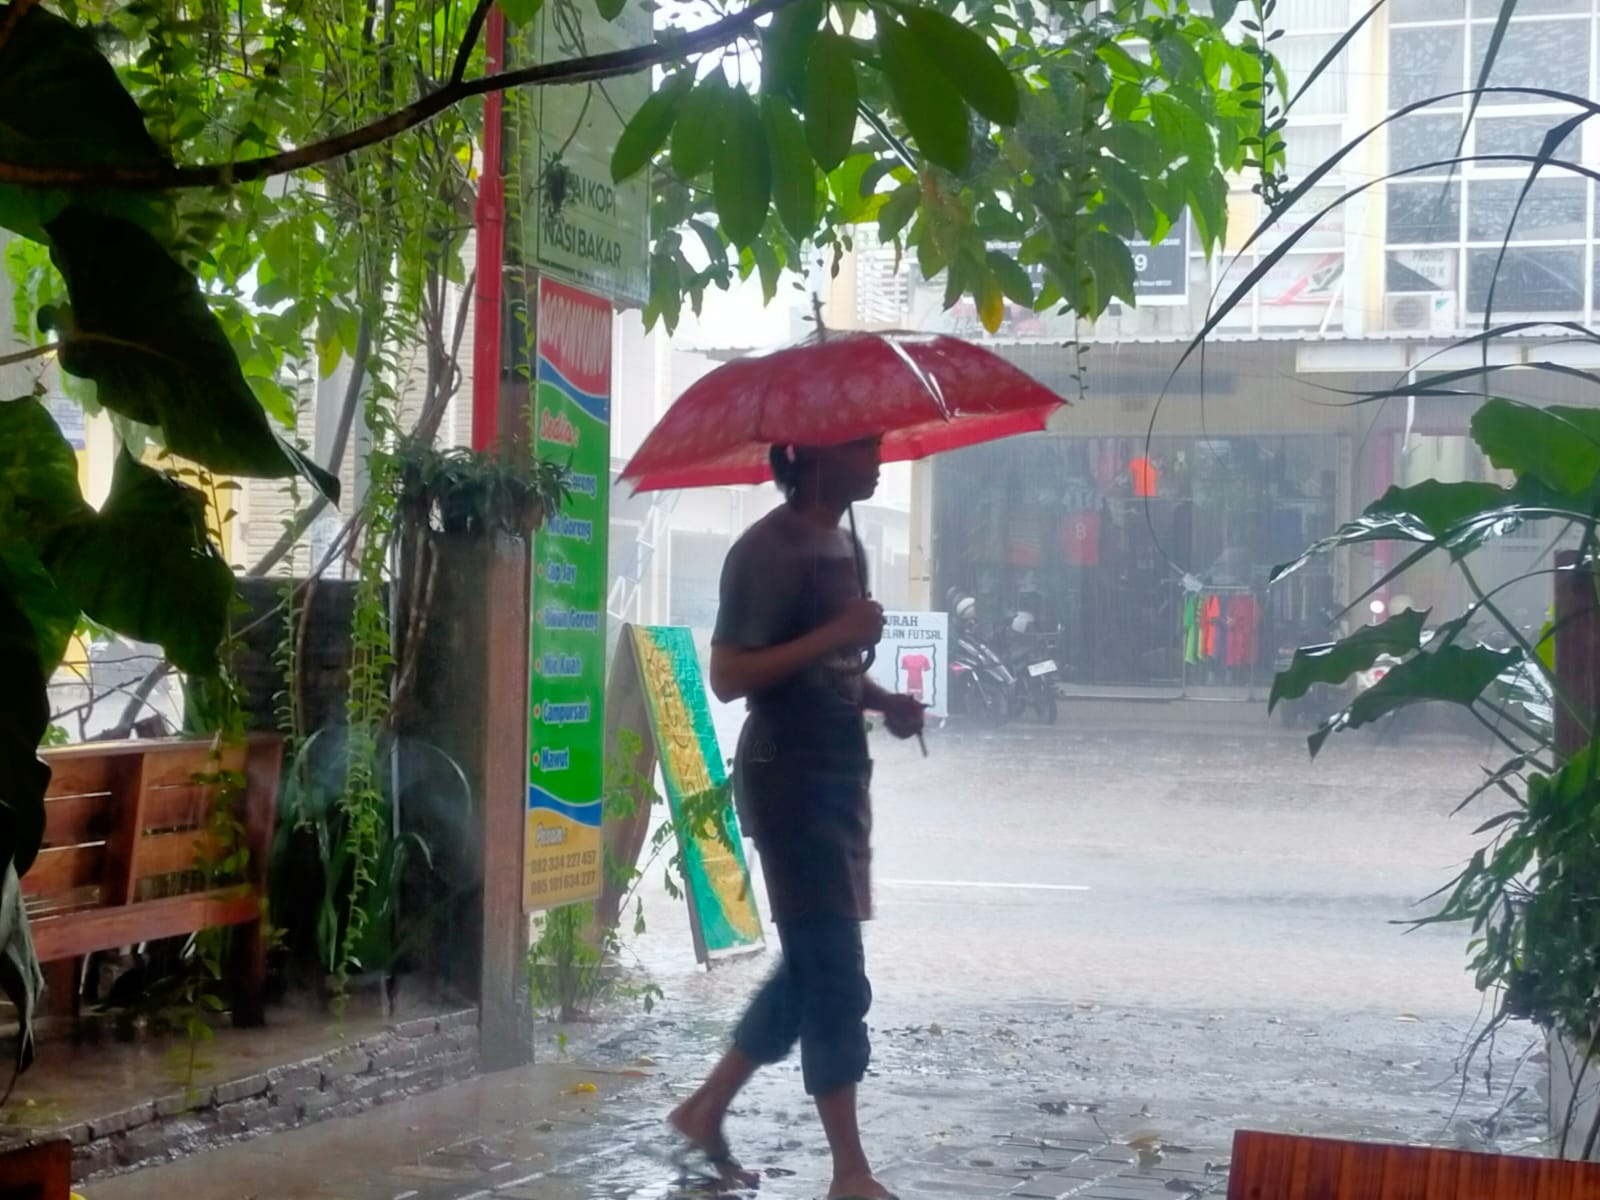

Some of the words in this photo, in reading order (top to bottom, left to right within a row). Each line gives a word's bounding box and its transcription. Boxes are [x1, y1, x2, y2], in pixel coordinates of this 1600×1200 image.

[588, 180, 617, 217] KOPI
[543, 218, 576, 254] NASI
[578, 229, 622, 269] BAKAR
[562, 514, 592, 542] Goreng
[569, 608, 599, 634] Goreng
[882, 629, 905, 640] ELAN
[907, 630, 943, 640] FUTSAL
[884, 615, 918, 627] URAH
